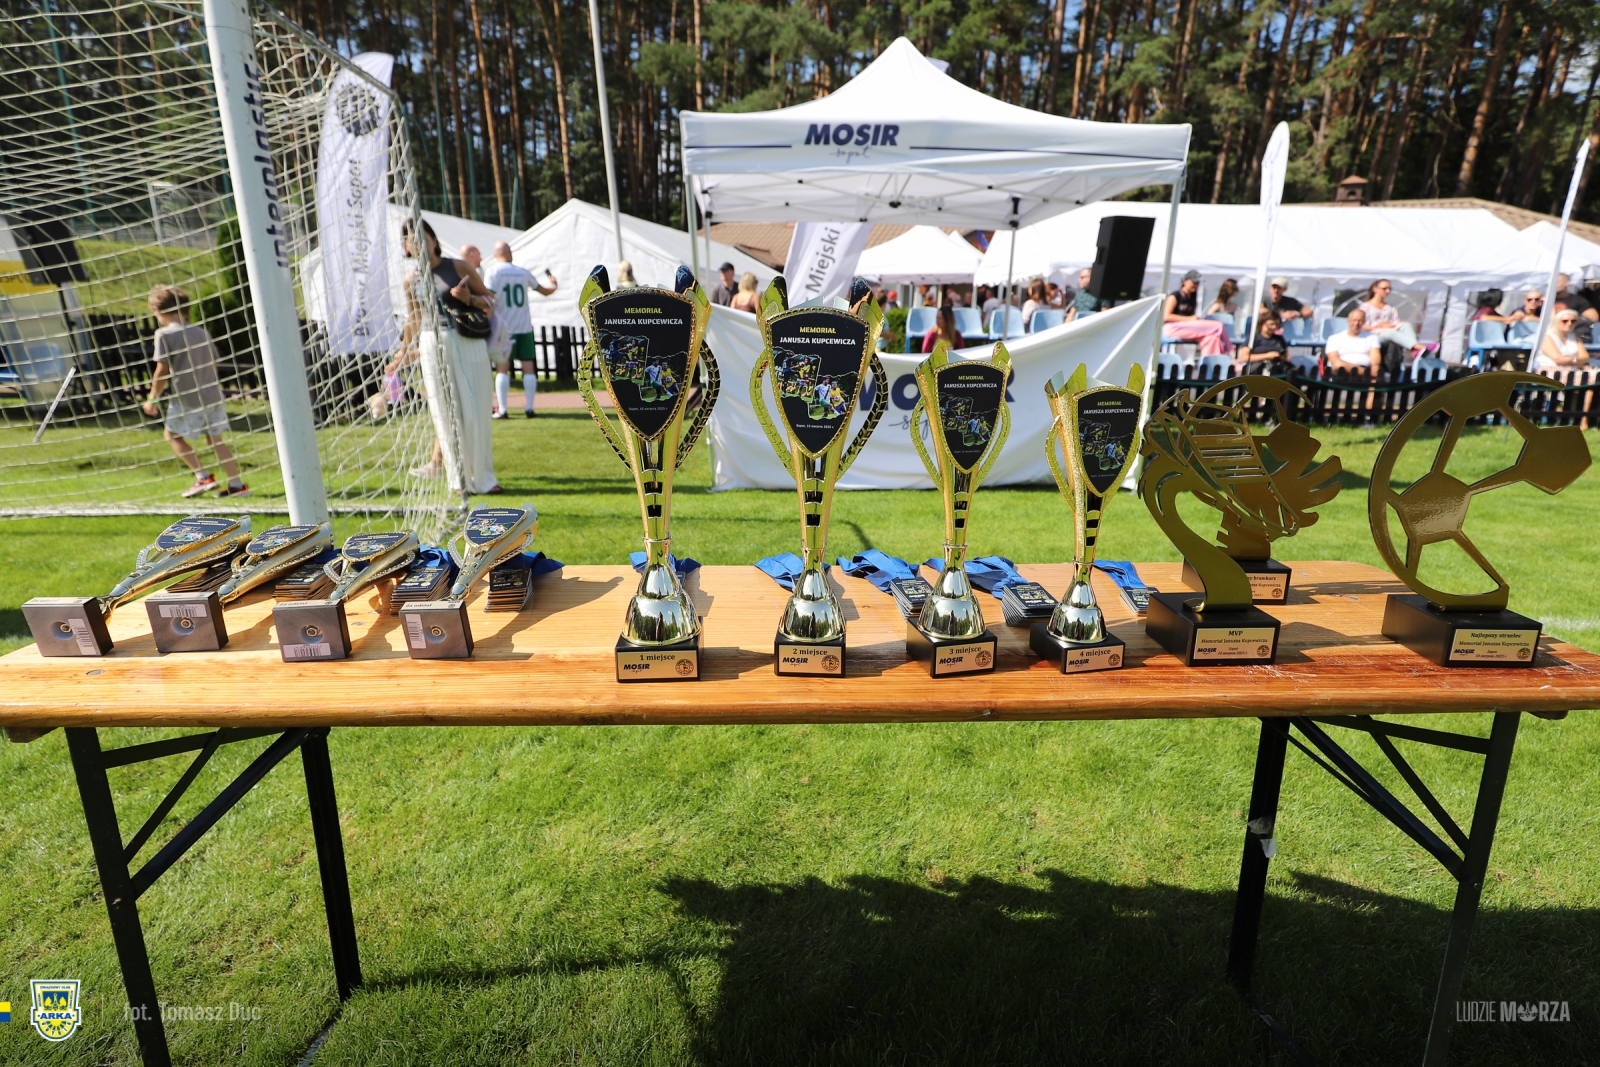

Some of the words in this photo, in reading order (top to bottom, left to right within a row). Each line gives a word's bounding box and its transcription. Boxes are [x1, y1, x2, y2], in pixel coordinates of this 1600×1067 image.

[804, 123, 900, 146] MOSIR
[346, 158, 368, 210] Sopot
[805, 226, 841, 293] Miejski
[502, 283, 525, 308] 10
[799, 326, 837, 334] MEMORIAŁ
[779, 336, 811, 344] JANUSZA
[811, 337, 856, 345] KUPCEWICZA
[799, 648, 828, 656] miejsce
[955, 646, 982, 654] miejsce
[1085, 649, 1111, 657] miejsce
[646, 654, 676, 662] miejsce
[939, 656, 964, 665] MOSIR
[1068, 658, 1090, 666] MOSIR
